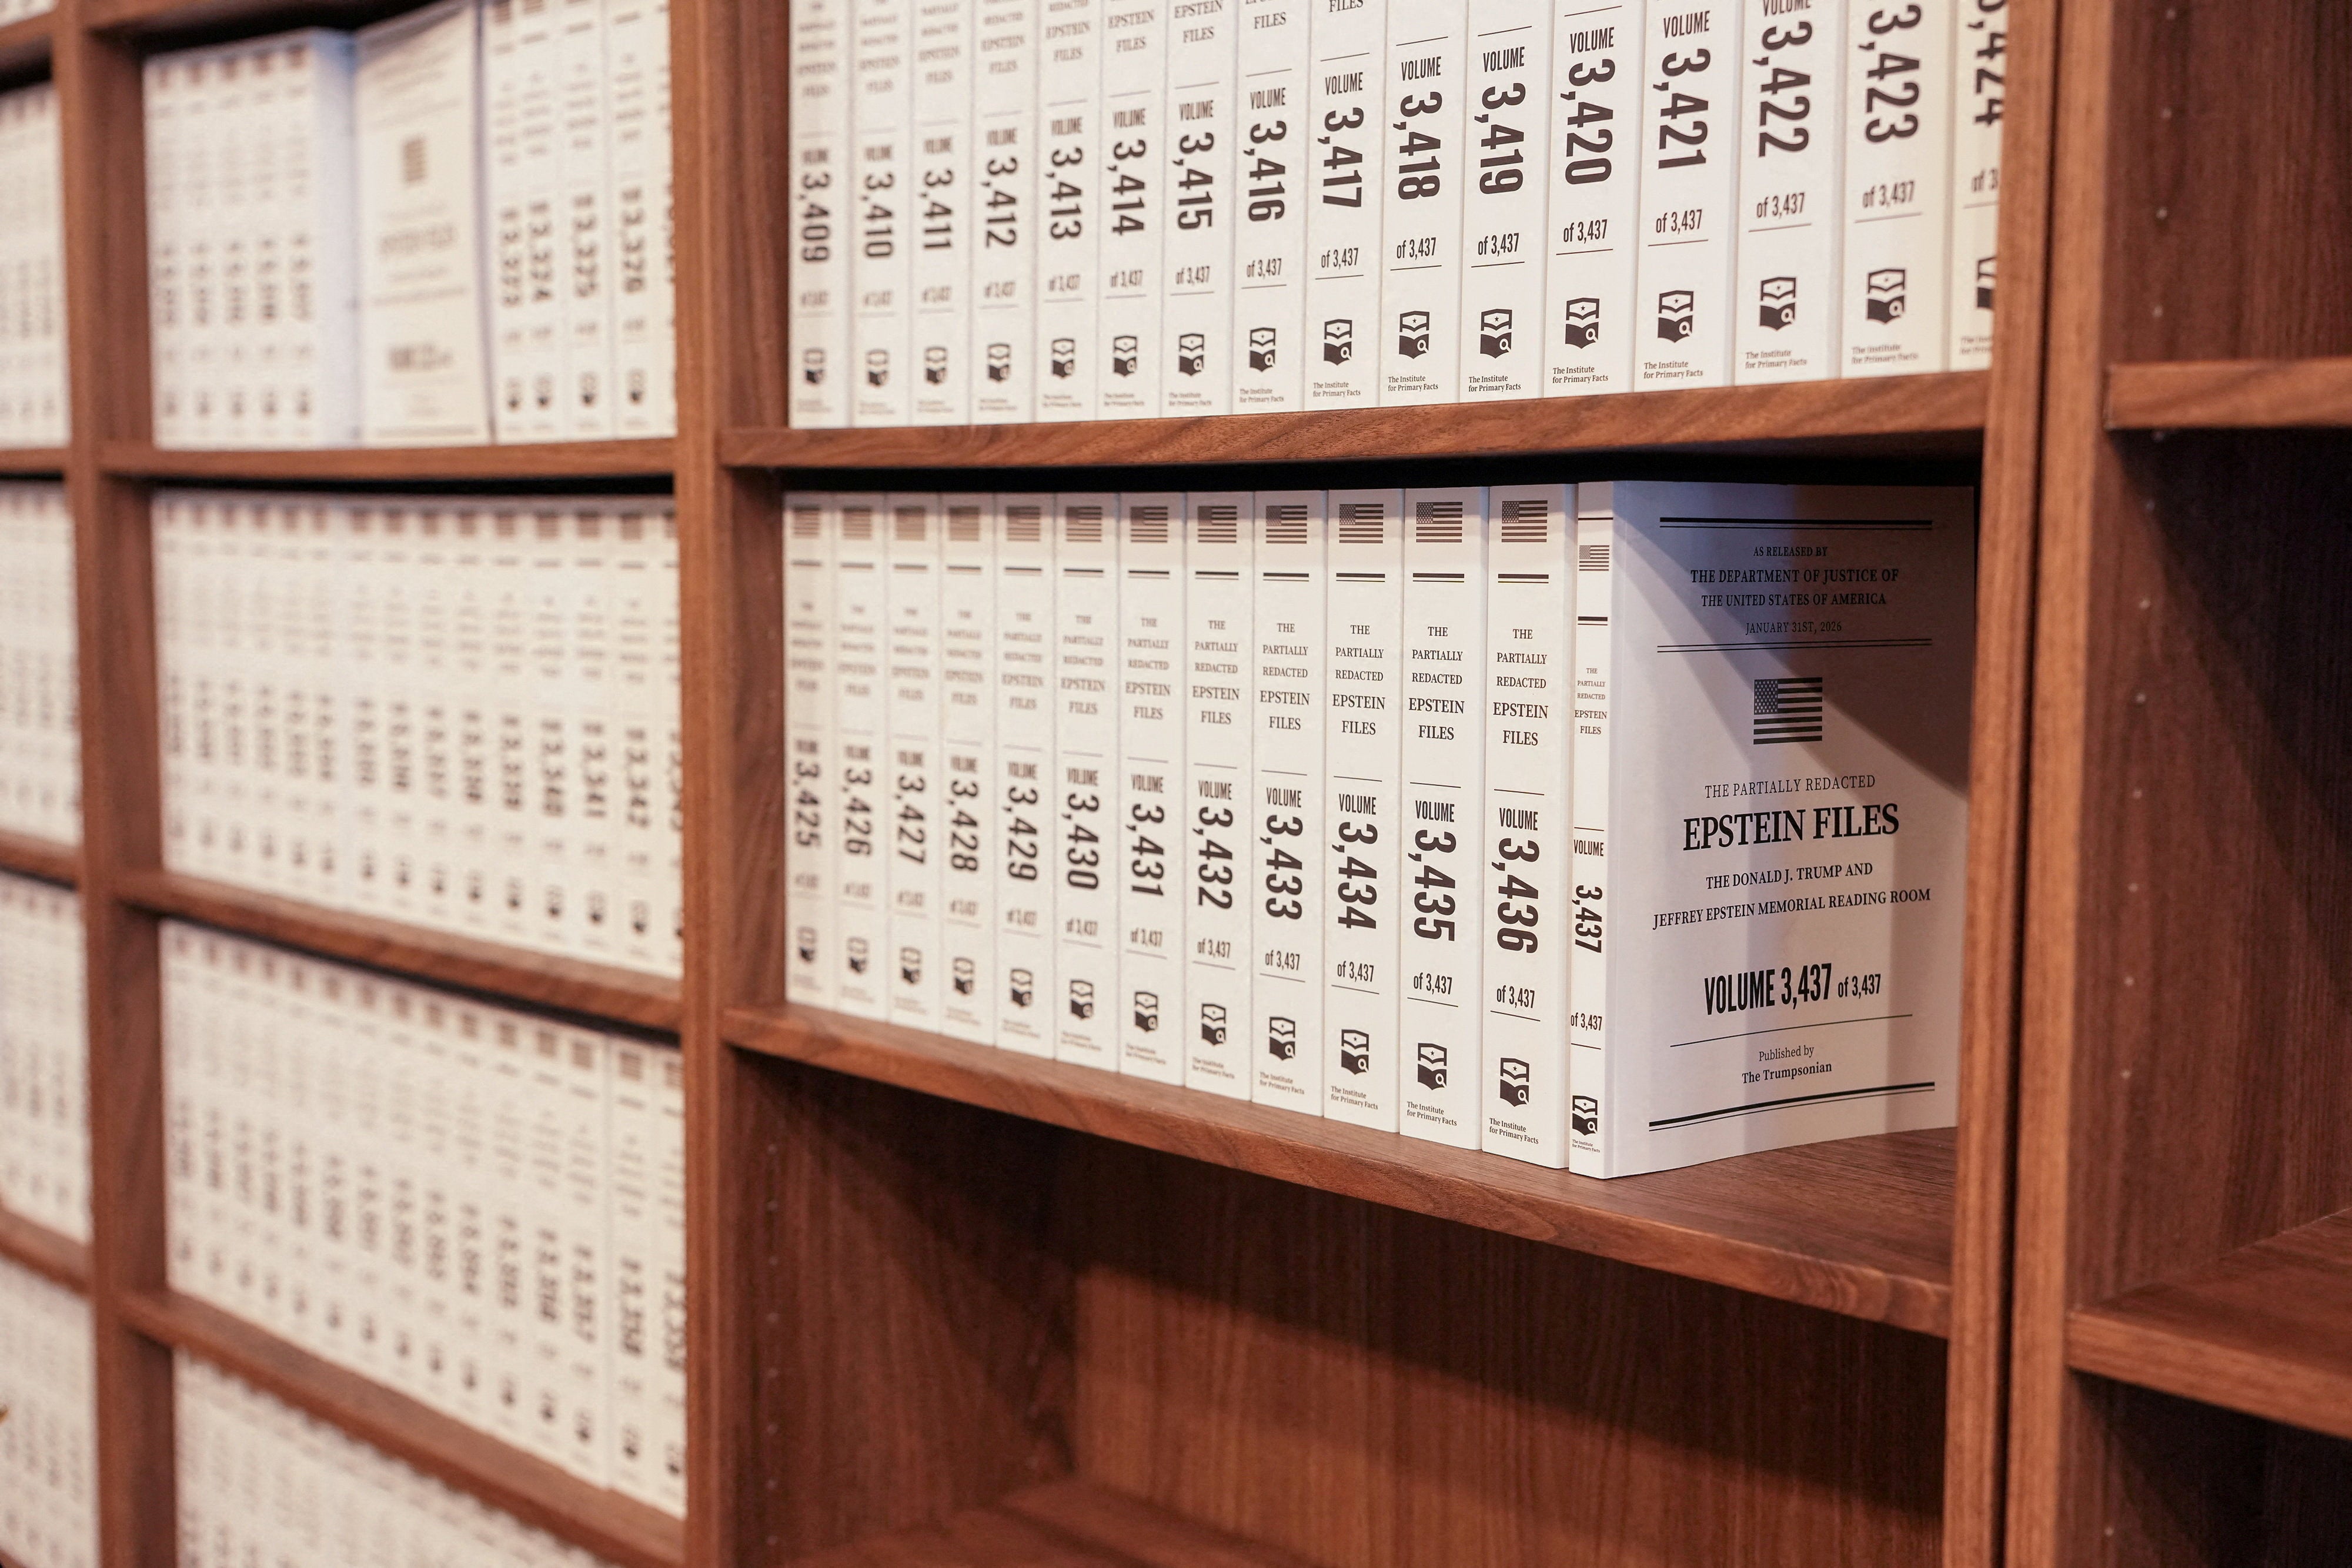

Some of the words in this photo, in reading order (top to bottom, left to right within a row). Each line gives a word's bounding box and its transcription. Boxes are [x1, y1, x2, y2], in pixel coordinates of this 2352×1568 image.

[1254, 12, 1286, 29] FILES
[1663, 11, 1710, 38] VOLUME
[1570, 27, 1614, 54] VOLUME
[1401, 56, 1441, 81] VOLUME
[1484, 46, 1525, 72] VOLUME
[1325, 72, 1363, 95] VOLUME
[1859, 4, 1922, 143] 3,423
[1753, 21, 1812, 157] 3,422
[1653, 49, 1710, 169] 3,421
[1561, 59, 1615, 185] 3,420
[1393, 92, 1442, 199] 3,418
[1475, 83, 1525, 194] 3,419
[1318, 108, 1364, 208] 3,417
[1172, 132, 1214, 230] 3,415
[1244, 121, 1287, 222] 3,416
[1046, 147, 1083, 240] 3,413
[1108, 139, 1146, 235] 3,414
[921, 169, 953, 249] 3,411
[982, 157, 1017, 247] 3,412
[1757, 198, 1768, 218] of
[1772, 192, 1805, 216] 3,437
[862, 173, 894, 258] 3,410
[1656, 213, 1667, 233] of
[1671, 209, 1702, 234] 3,437
[1563, 223, 1574, 242] of
[1578, 219, 1607, 243] 3,437
[1397, 240, 1406, 259] of
[1409, 238, 1436, 260] 3,437
[1478, 236, 1488, 255] of
[1491, 233, 1519, 256] 3,437
[1321, 250, 1330, 268] of
[1334, 248, 1358, 268] 3,437
[1753, 547, 1763, 556] AS
[1766, 547, 1813, 556] RELEASED
[1816, 547, 1828, 556] BY
[1690, 570, 1715, 583] THE
[1719, 570, 1799, 582] DEPARTMENT
[1804, 569, 1820, 582] OF
[1822, 569, 1877, 585] JUSTICE
[1882, 569, 1899, 581] OF
[1702, 595, 1722, 606] THE
[1726, 594, 1765, 606] UNITED
[1769, 594, 1809, 606] STATES
[1813, 594, 1828, 605] OF
[1831, 593, 1886, 605] AMERICA
[1277, 623, 1295, 633] THE
[1351, 625, 1369, 634] THE
[1428, 627, 1448, 636] THE
[1513, 629, 1532, 639] THE
[1746, 622, 1789, 635] JANUARY
[1792, 621, 1816, 634] 31ST,
[1820, 621, 1842, 631] 2026
[1263, 645, 1308, 656] PARTIALLY
[1336, 647, 1384, 658] PARTIALLY
[1412, 650, 1462, 661] PARTIALLY
[1497, 653, 1547, 664] PARTIALLY
[1263, 667, 1308, 677] REDACTED
[1336, 670, 1383, 681] REDACTED
[1412, 673, 1462, 684] REDACTED
[1496, 677, 1546, 688] REDACTED
[1261, 691, 1309, 705] EPSTEIN
[1333, 694, 1385, 709] EPSTEIN
[1409, 698, 1465, 714] EPSTEIN
[1493, 703, 1548, 718] EPSTEIN
[1575, 710, 1606, 718] EPSTEIN
[1269, 717, 1301, 730] FILES
[1342, 721, 1375, 735] FILES
[1419, 725, 1454, 740] FILES
[1581, 726, 1601, 734] FILES
[1503, 730, 1538, 745] FILES
[1199, 781, 1232, 800] VOLUME
[1705, 784, 1729, 798] THE
[1733, 779, 1801, 795] PARTIALLY
[1806, 775, 1875, 791] REDACTED
[1267, 788, 1301, 808] VOLUME
[1339, 794, 1376, 815] VOLUME
[843, 768, 871, 855] 3,426
[896, 775, 926, 864] 3,427
[1415, 800, 1454, 822] VOLUME
[1499, 808, 1538, 831] VOLUME
[948, 781, 978, 872] 3,428
[1004, 787, 1038, 881] 3,429
[1683, 810, 1806, 851] EPSTEIN
[1813, 803, 1899, 839] FILES
[1063, 794, 1099, 890] 3,430
[1127, 804, 1164, 896] 3,431
[1574, 840, 1603, 856] VOLUME
[1193, 807, 1233, 909] 3,432
[1260, 815, 1303, 920] 3,433
[1332, 822, 1378, 929] 3,434
[1408, 830, 1456, 941] 3,435
[1706, 875, 1729, 889] THE
[1733, 870, 1782, 886] DONALD
[1784, 869, 1792, 884] J.
[1796, 865, 1842, 880] TRUMP
[1845, 863, 1872, 876] AND
[1492, 838, 1539, 953] 3,436
[1572, 885, 1602, 953] 3,437
[1653, 910, 1703, 930] JEFFREY
[1706, 904, 1755, 921] EPSTEIN
[1758, 897, 1825, 915] MEMORIAL
[1829, 892, 1886, 908] READING
[1890, 889, 1930, 902] ROOM
[1265, 950, 1274, 966] of
[1277, 951, 1299, 970] 3,437
[1338, 961, 1346, 977] of
[1349, 962, 1374, 982] 3,437
[1414, 972, 1423, 989] of
[1426, 974, 1452, 994] 3,437
[1705, 969, 1775, 1015] VOLUME
[1781, 963, 1831, 1009] 3,437
[1838, 977, 1849, 998] of
[1852, 974, 1880, 999] 3,437
[1497, 985, 1506, 1003] of
[1509, 986, 1535, 1008] 3,437
[1571, 1012, 1578, 1027] of
[1581, 1014, 1602, 1031] 3,437
[1759, 1046, 1801, 1061] Published
[1804, 1045, 1814, 1058] by
[1742, 1072, 1760, 1084] The
[1763, 1062, 1832, 1080] Trumpsonian
[1417, 1112, 1441, 1124] Primary
[1442, 1117, 1457, 1126] Facts
[1419, 1104, 1444, 1115] Institute
[1489, 1118, 1501, 1126] The
[1501, 1120, 1526, 1132] Institute
[1499, 1128, 1524, 1142] Primary
[1524, 1135, 1539, 1144] Facts
